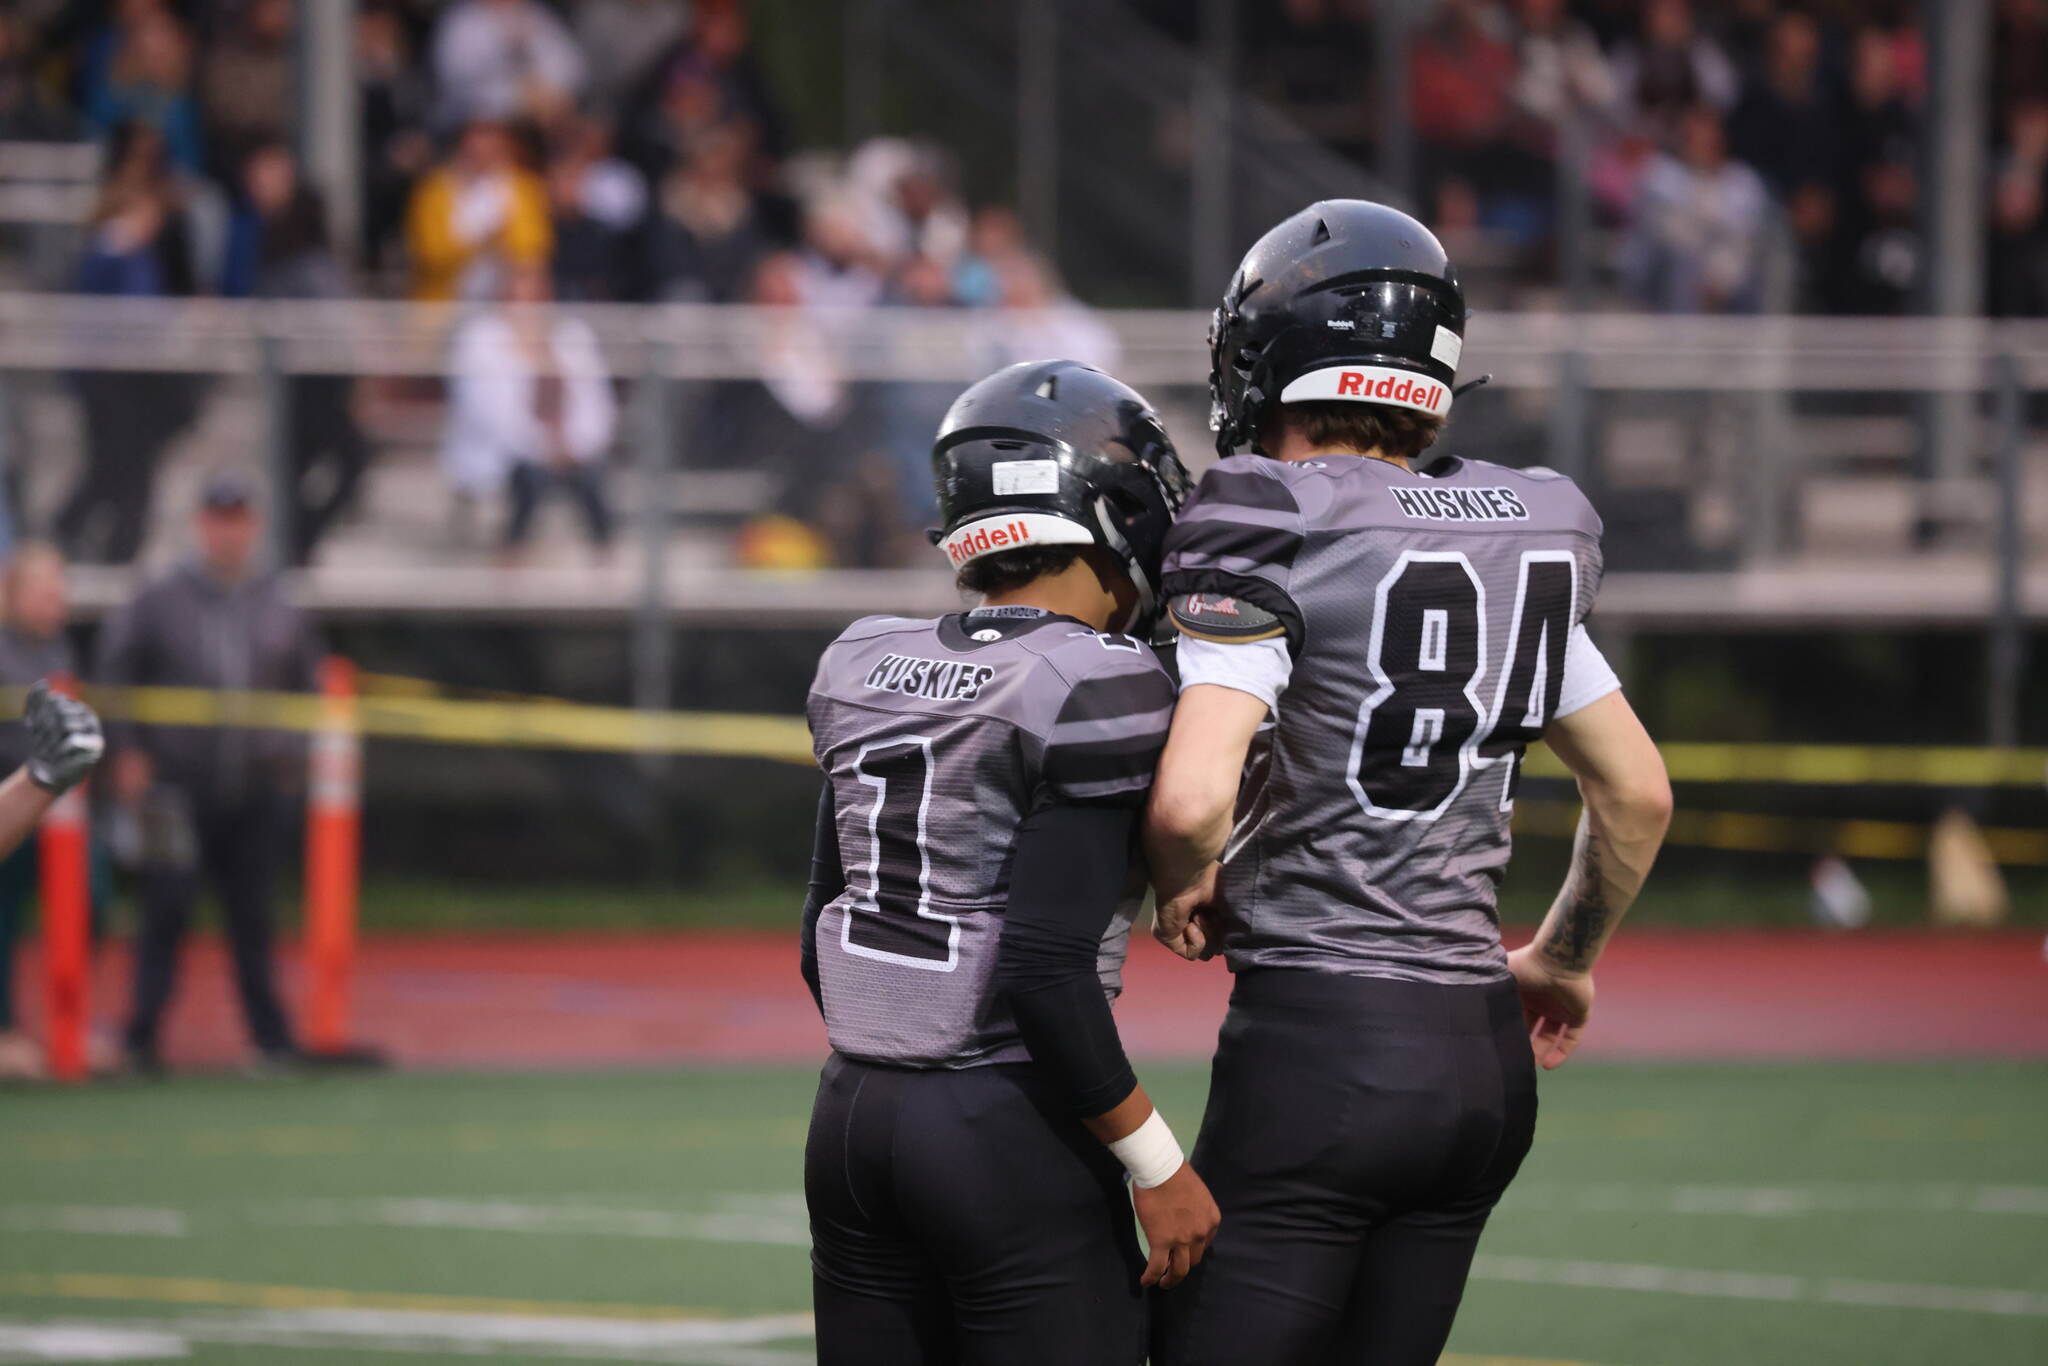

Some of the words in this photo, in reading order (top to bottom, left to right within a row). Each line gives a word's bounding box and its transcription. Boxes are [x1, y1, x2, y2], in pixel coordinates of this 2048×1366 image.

[1337, 372, 1442, 411] Riddell
[1388, 486, 1530, 521] HUSKIES
[948, 520, 1030, 565] Riddell
[864, 653, 995, 702] HUSKIES
[1345, 550, 1577, 821] 84
[841, 734, 961, 972] 1
